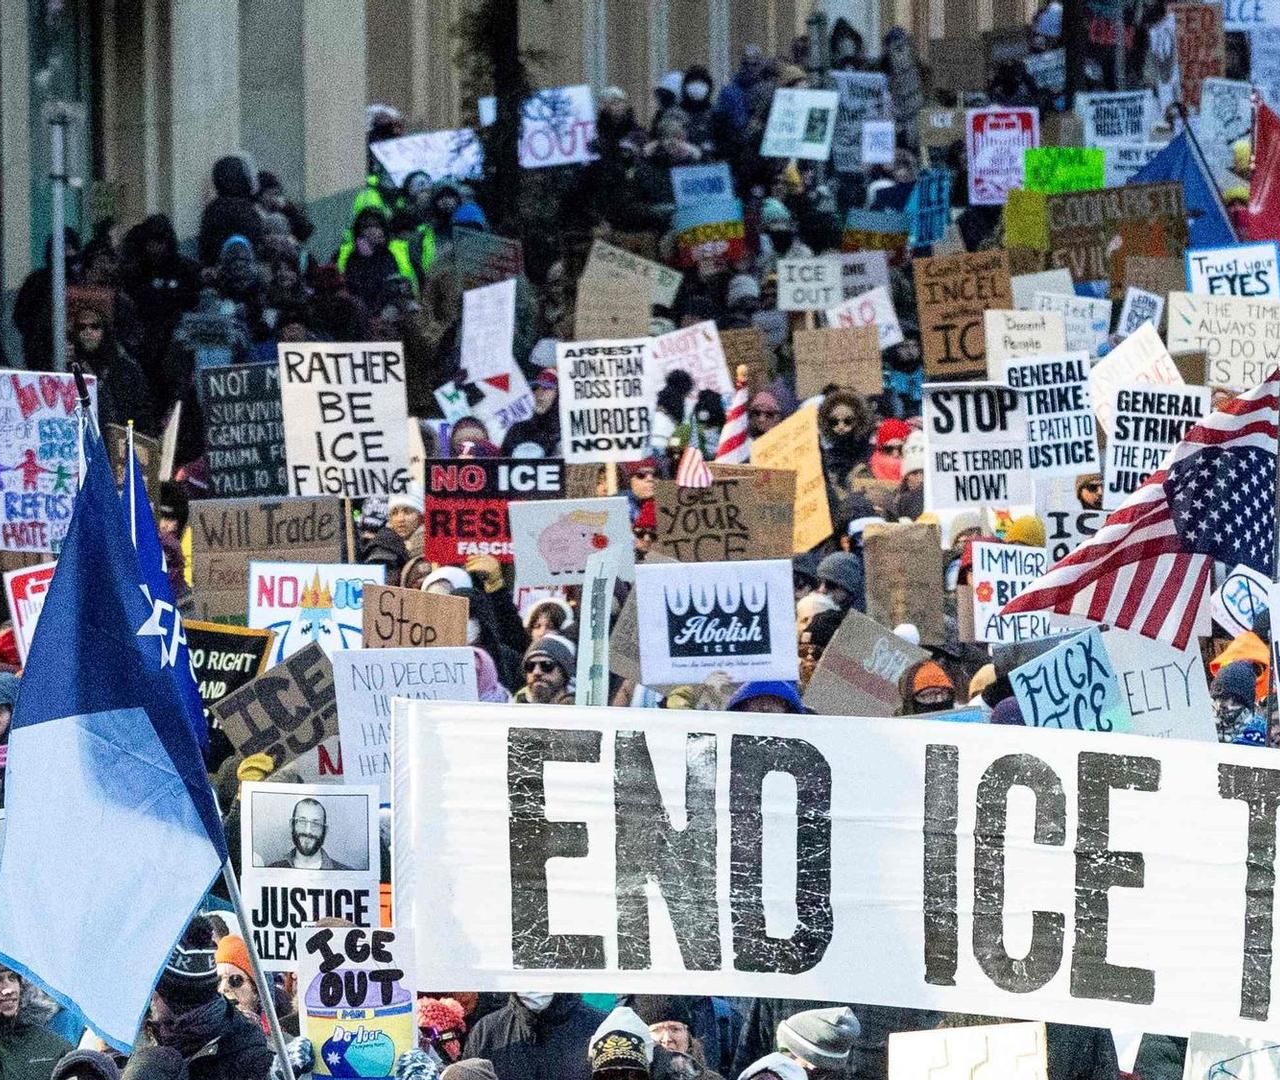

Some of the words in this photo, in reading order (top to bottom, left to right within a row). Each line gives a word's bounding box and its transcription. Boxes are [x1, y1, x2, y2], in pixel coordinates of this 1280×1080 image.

[1192, 256, 1239, 274] Trust
[1208, 271, 1270, 298] EYES
[1245, 303, 1280, 320] TIME
[1198, 318, 1256, 337] ALWAYS
[564, 344, 646, 359] ARREST
[1195, 336, 1220, 357] TO
[209, 369, 250, 397] NOT
[285, 351, 403, 385] RATHER
[568, 358, 645, 380] JONATHAN
[1007, 360, 1087, 388] GENERAL
[574, 378, 612, 400] ROSS
[615, 379, 644, 399] FOR
[1117, 389, 1204, 418] GENERAL
[317, 391, 375, 424] BE
[570, 408, 650, 435] MURDER
[933, 391, 1018, 436] STOP
[1074, 415, 1093, 438] TO
[315, 431, 390, 463] ICE
[571, 436, 647, 453] NOW
[964, 450, 1022, 472] TERROR
[293, 465, 412, 497] FISHING
[432, 465, 485, 492] NO
[497, 463, 560, 492] ICE
[955, 472, 1008, 503] NOW!
[199, 509, 251, 547] Will
[260, 503, 336, 546] Trade
[661, 504, 750, 535] YOUR
[257, 575, 298, 607] NO
[374, 589, 437, 646] Stop
[674, 614, 763, 646] Abolish
[352, 663, 385, 691] NO
[391, 661, 467, 691] DECENT
[507, 725, 834, 976] END
[922, 741, 1162, 1006] ICE
[252, 885, 372, 930] JUSTICE
[253, 929, 300, 962] ALEX
[304, 928, 396, 974] ICE
[318, 969, 405, 1008] OUT
